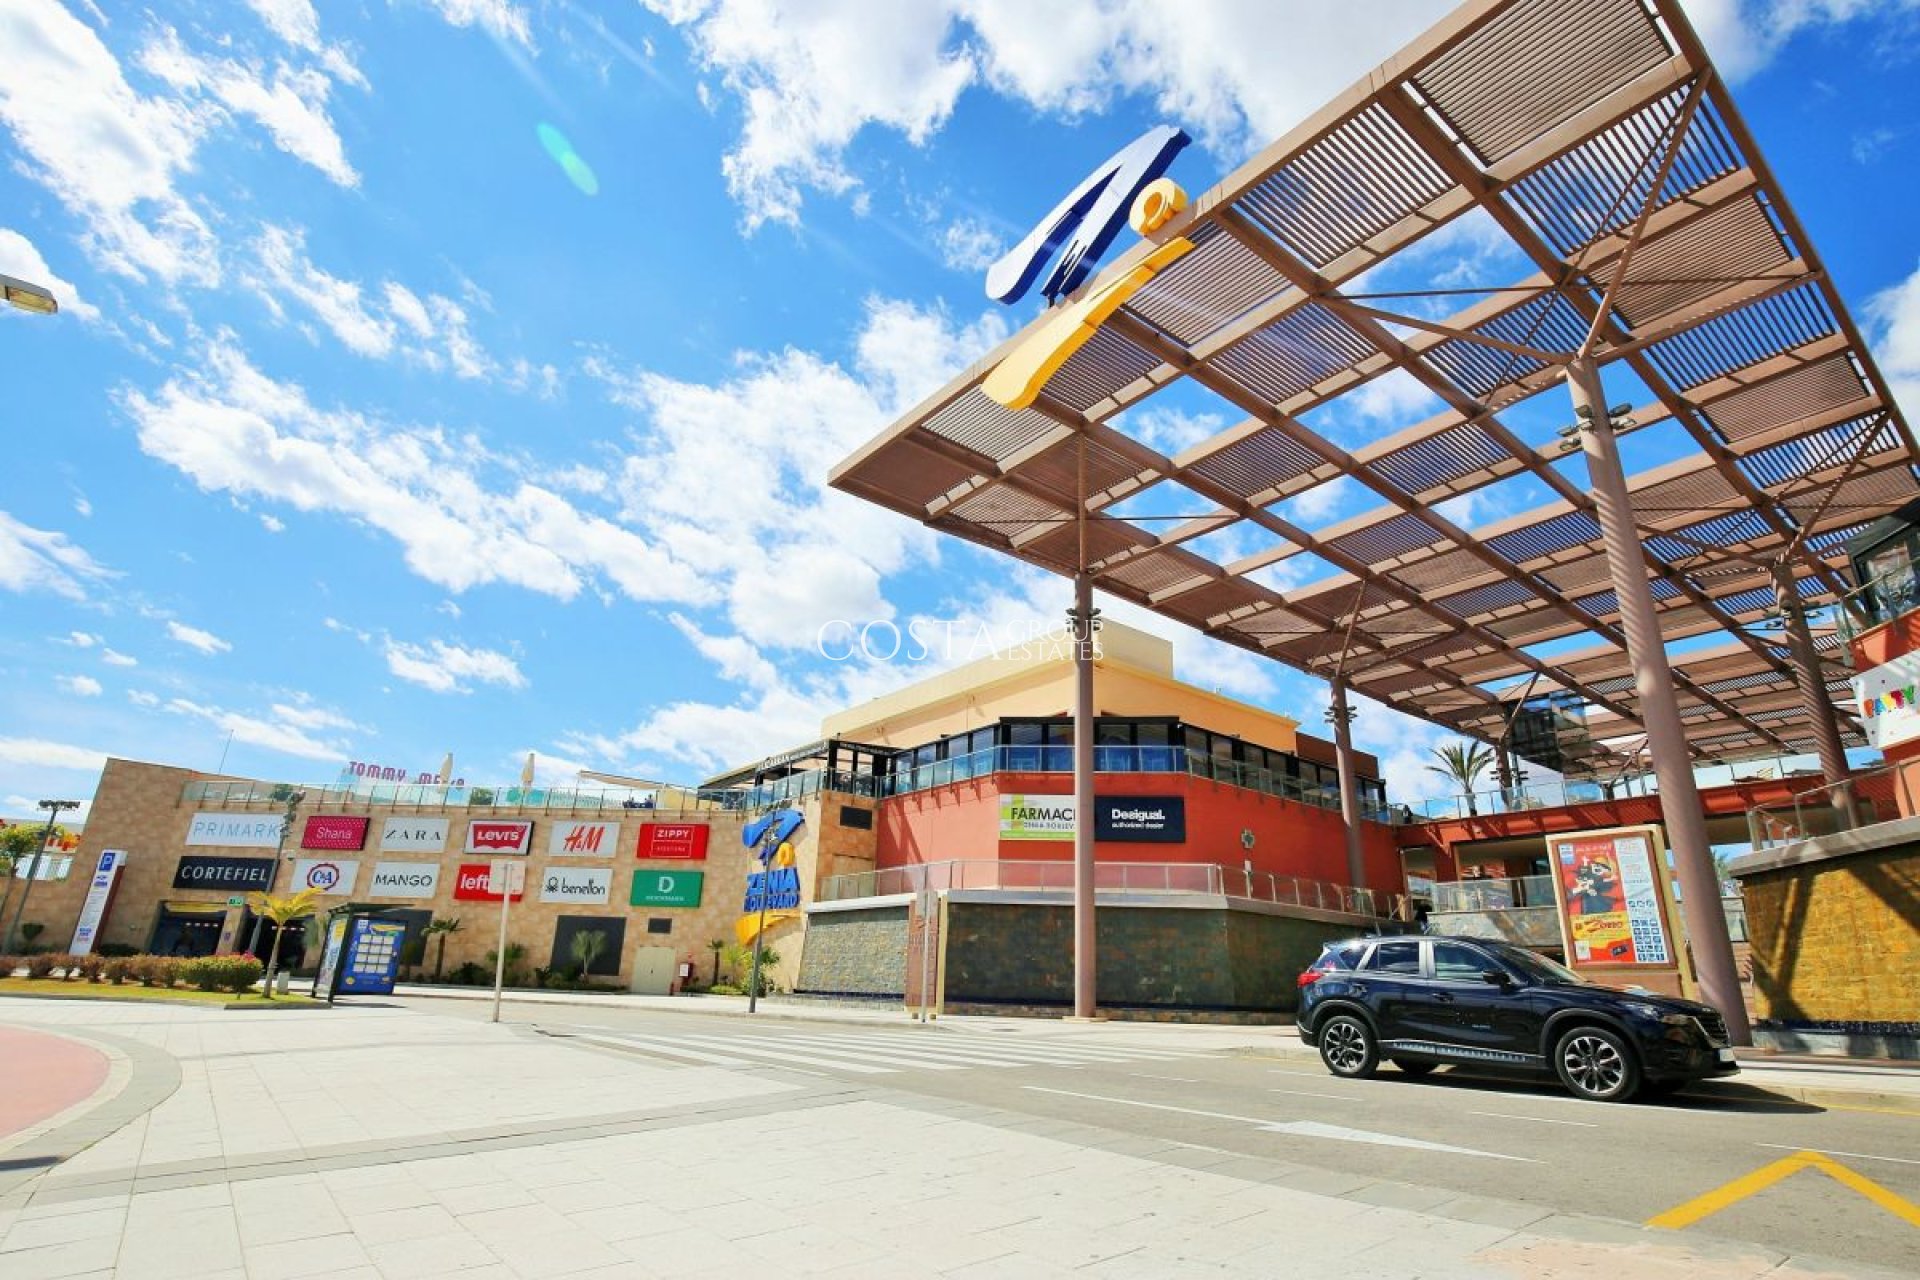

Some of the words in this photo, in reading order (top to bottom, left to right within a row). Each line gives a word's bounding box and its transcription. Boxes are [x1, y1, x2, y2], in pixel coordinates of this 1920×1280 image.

[349, 761, 406, 782] TOMMY
[1011, 807, 1076, 822] FARMACI
[193, 821, 281, 840] PRIMARK
[316, 826, 352, 840] Shana
[385, 829, 441, 841] ZARA
[657, 829, 689, 838] ZIPPY
[563, 825, 605, 853] H&M
[181, 866, 267, 881] CORTEFIEL
[312, 870, 332, 884] C&A
[375, 874, 433, 887] MANGO
[460, 873, 490, 890] left
[561, 877, 606, 896] benetton
[658, 876, 675, 893] D
[746, 868, 800, 896] ZENIA
